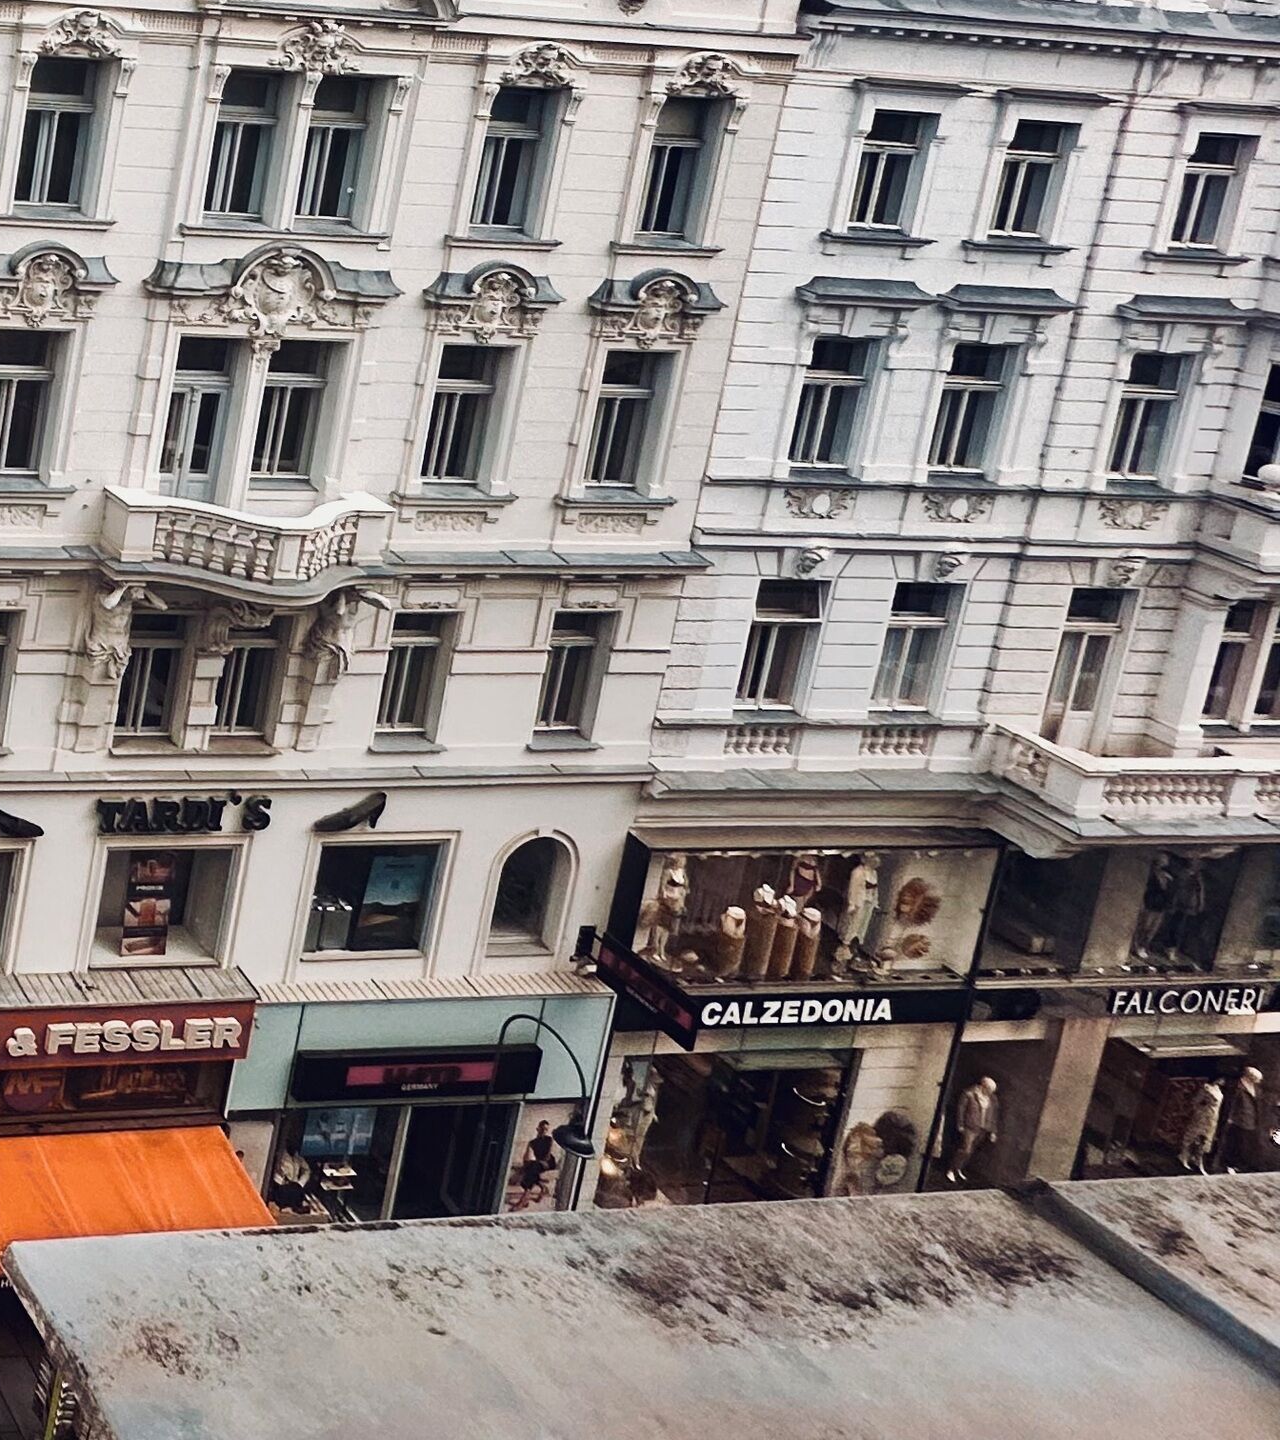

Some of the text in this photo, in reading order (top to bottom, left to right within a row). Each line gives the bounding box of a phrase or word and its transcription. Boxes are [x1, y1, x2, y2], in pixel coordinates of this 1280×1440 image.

[97, 789, 272, 834] TARDI'S
[701, 998, 892, 1026] CALZEDONIA
[1112, 988, 1264, 1014] FALCONERI
[6, 1027, 38, 1057] &
[47, 1017, 242, 1055] FESSLER
